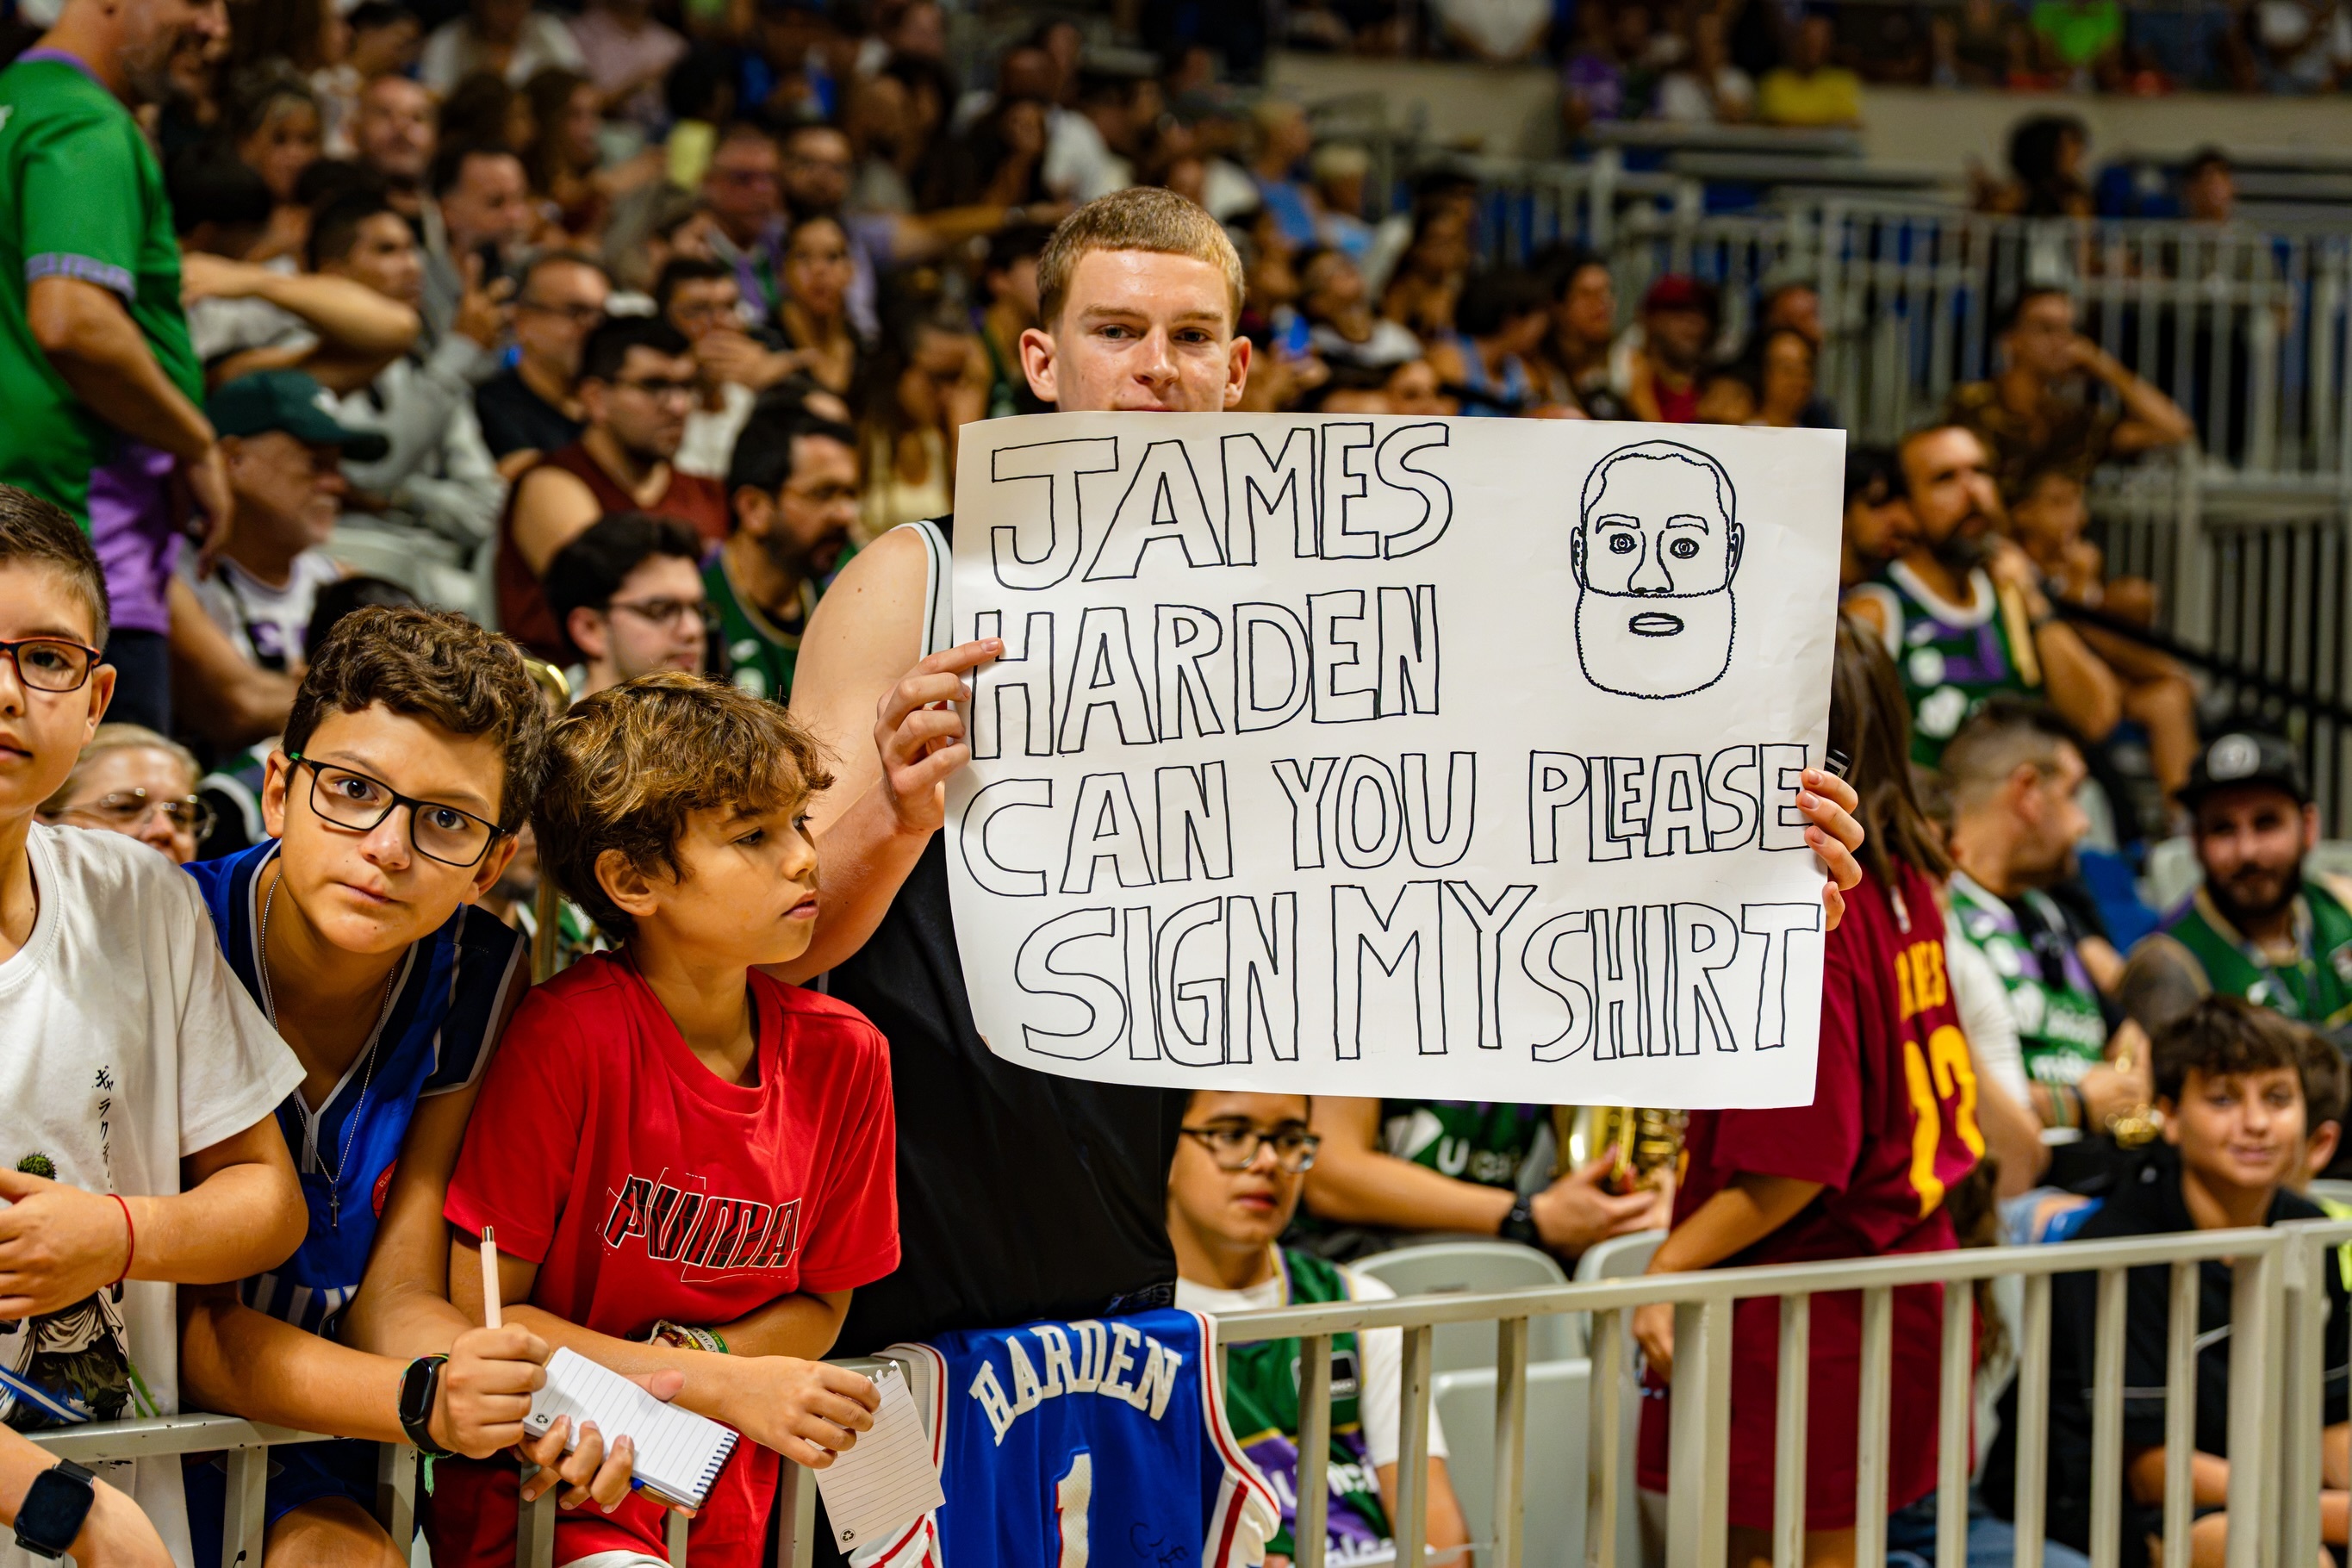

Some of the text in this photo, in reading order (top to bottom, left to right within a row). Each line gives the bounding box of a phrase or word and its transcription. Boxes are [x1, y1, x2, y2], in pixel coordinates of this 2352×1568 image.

[990, 421, 1453, 591] JAMES
[970, 583, 1440, 760] HARDEN
[960, 743, 1812, 898] CAN YOU PLEASE
[1014, 891, 1299, 1067] SIGN
[1330, 878, 1539, 1061] MY
[1521, 901, 1821, 1063] SHIRT
[603, 1173, 801, 1270] PUMA
[968, 1319, 1183, 1447] HARDEN
